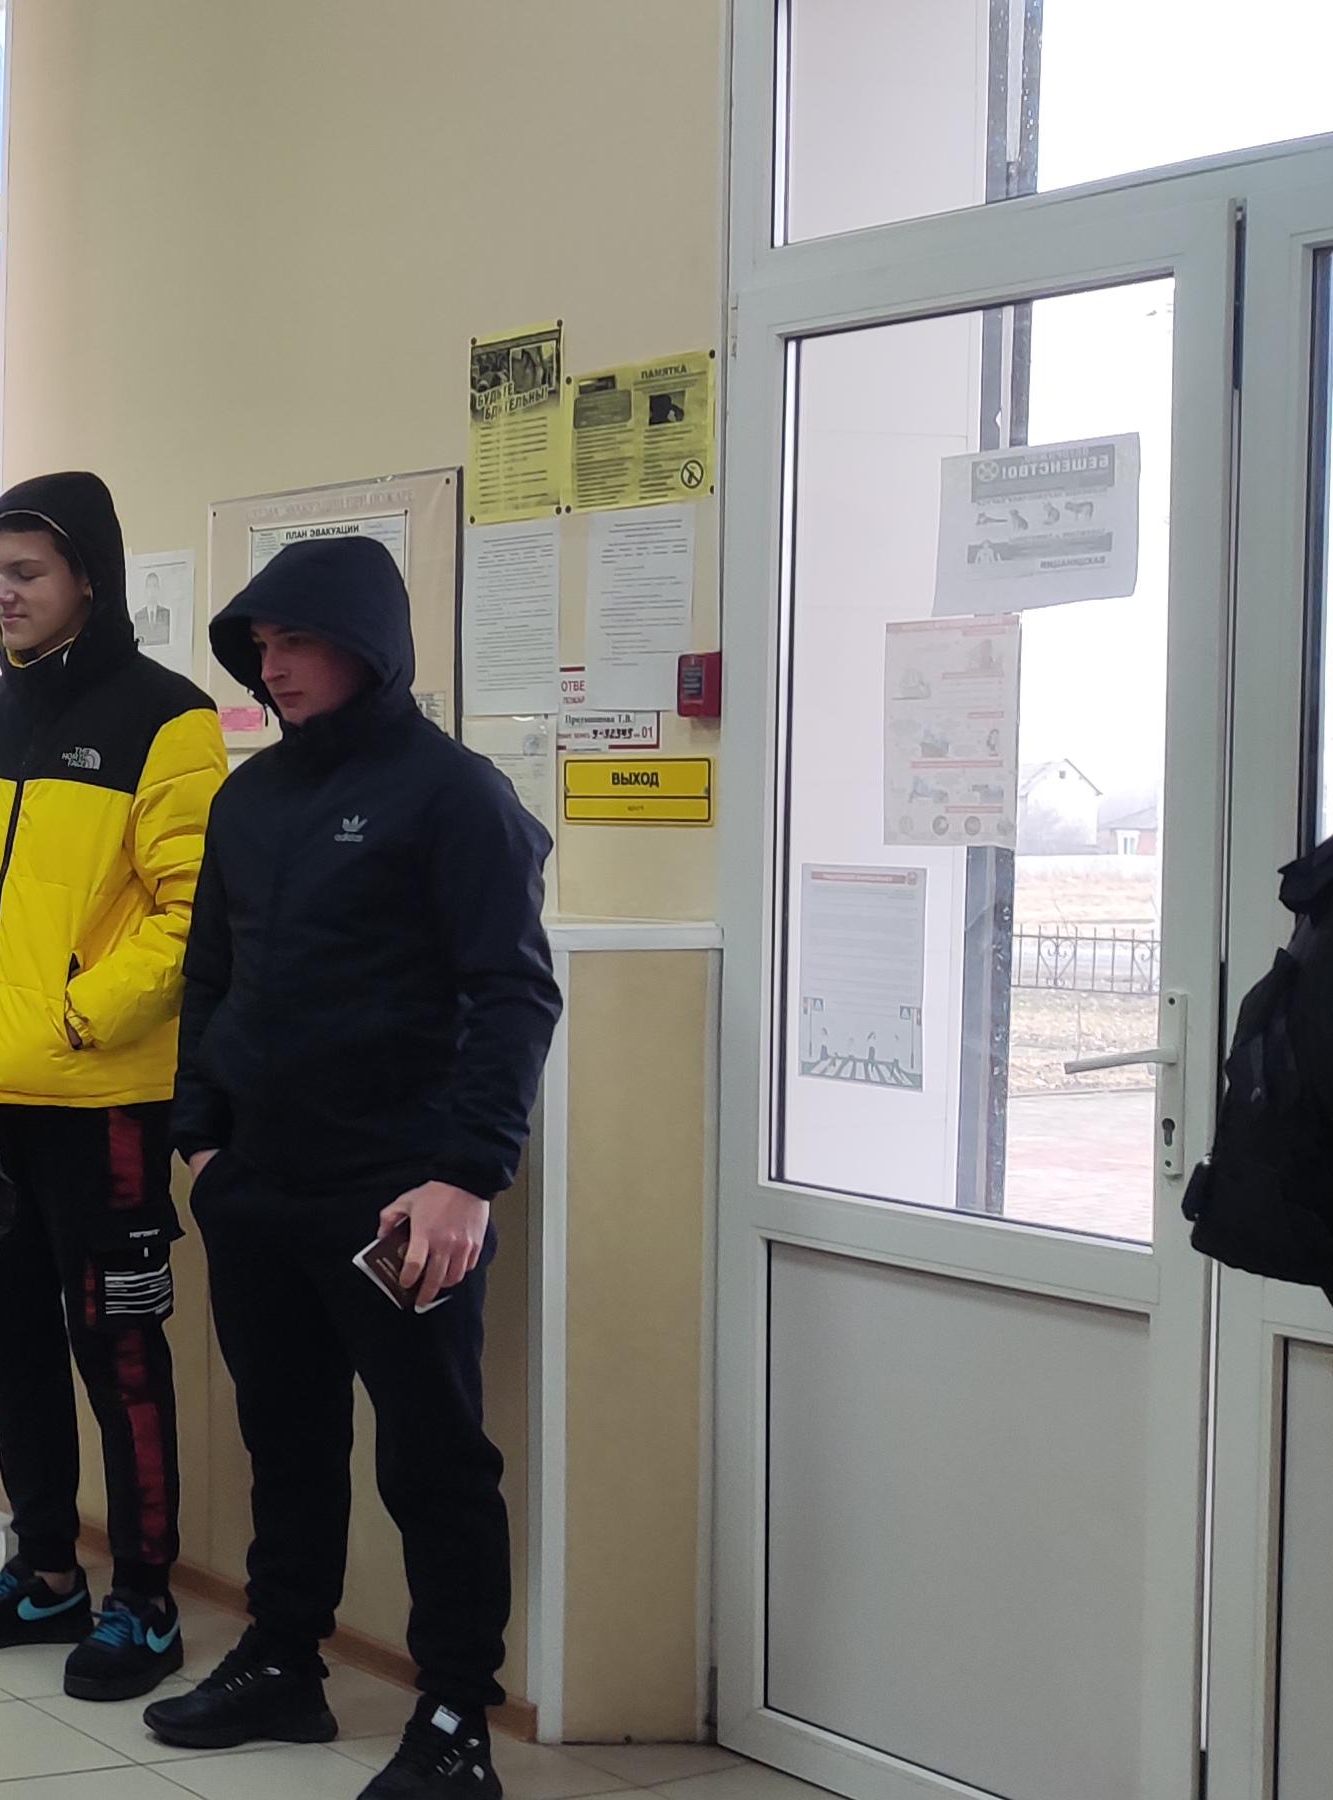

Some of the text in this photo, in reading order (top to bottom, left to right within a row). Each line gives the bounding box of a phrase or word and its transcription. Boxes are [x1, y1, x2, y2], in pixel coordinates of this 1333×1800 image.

[641, 364, 687, 380] ПАМЯТКА
[484, 386, 548, 421] БДТЕЛЬНЫ!
[285, 530, 308, 540] ПЛАН
[309, 524, 360, 538] ЭВАКУАЦИИ
[641, 726, 653, 739] 01
[611, 772, 660, 788] ВЫХОД
